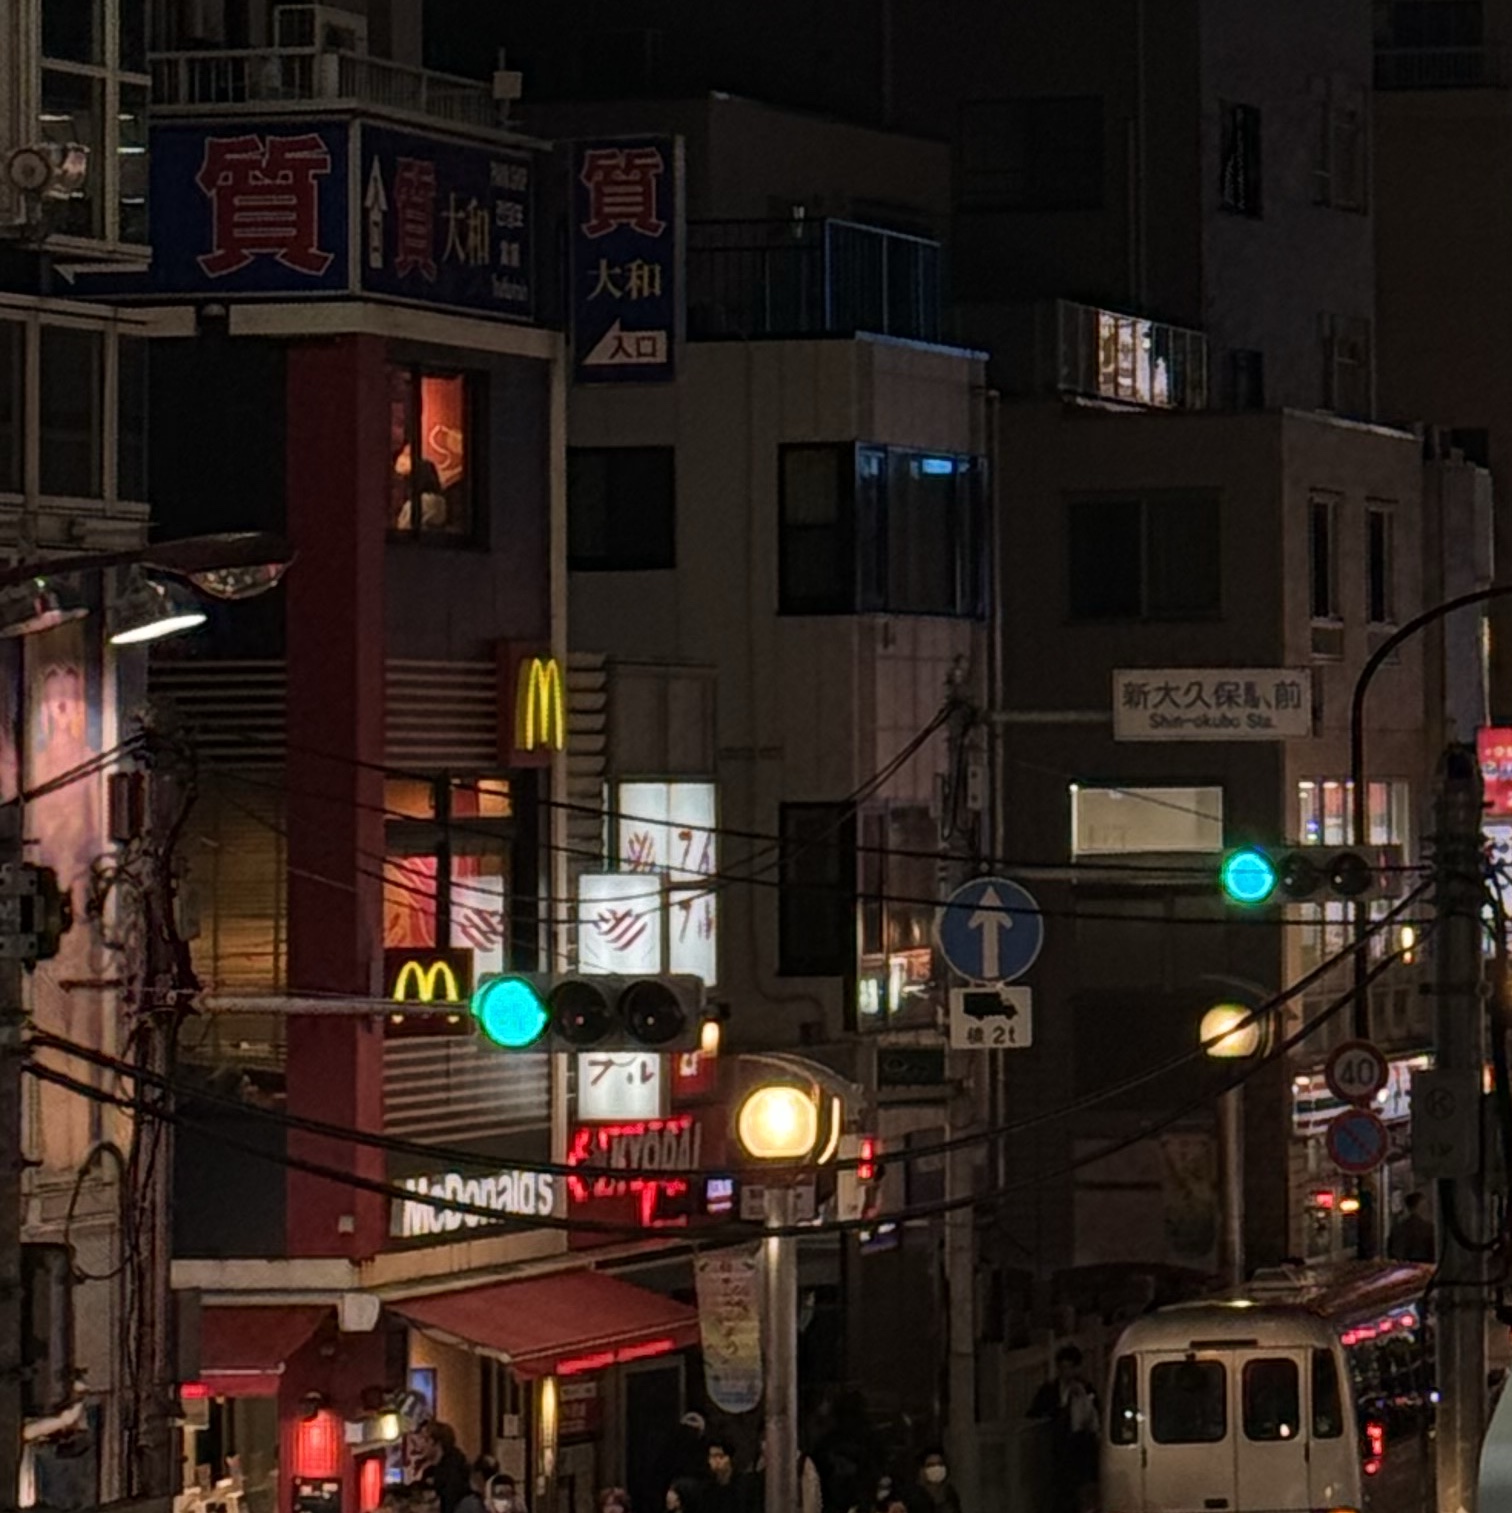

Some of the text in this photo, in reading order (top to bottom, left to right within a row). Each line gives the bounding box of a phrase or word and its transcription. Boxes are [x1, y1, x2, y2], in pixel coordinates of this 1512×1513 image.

[195, 133, 335, 279] 質
[579, 146, 667, 239] 質
[586, 257, 662, 301] 大和
[610, 335, 656, 359] 入口
[1122, 680, 1301, 710] 新大久保駅前
[1340, 1055, 1374, 1086] 40
